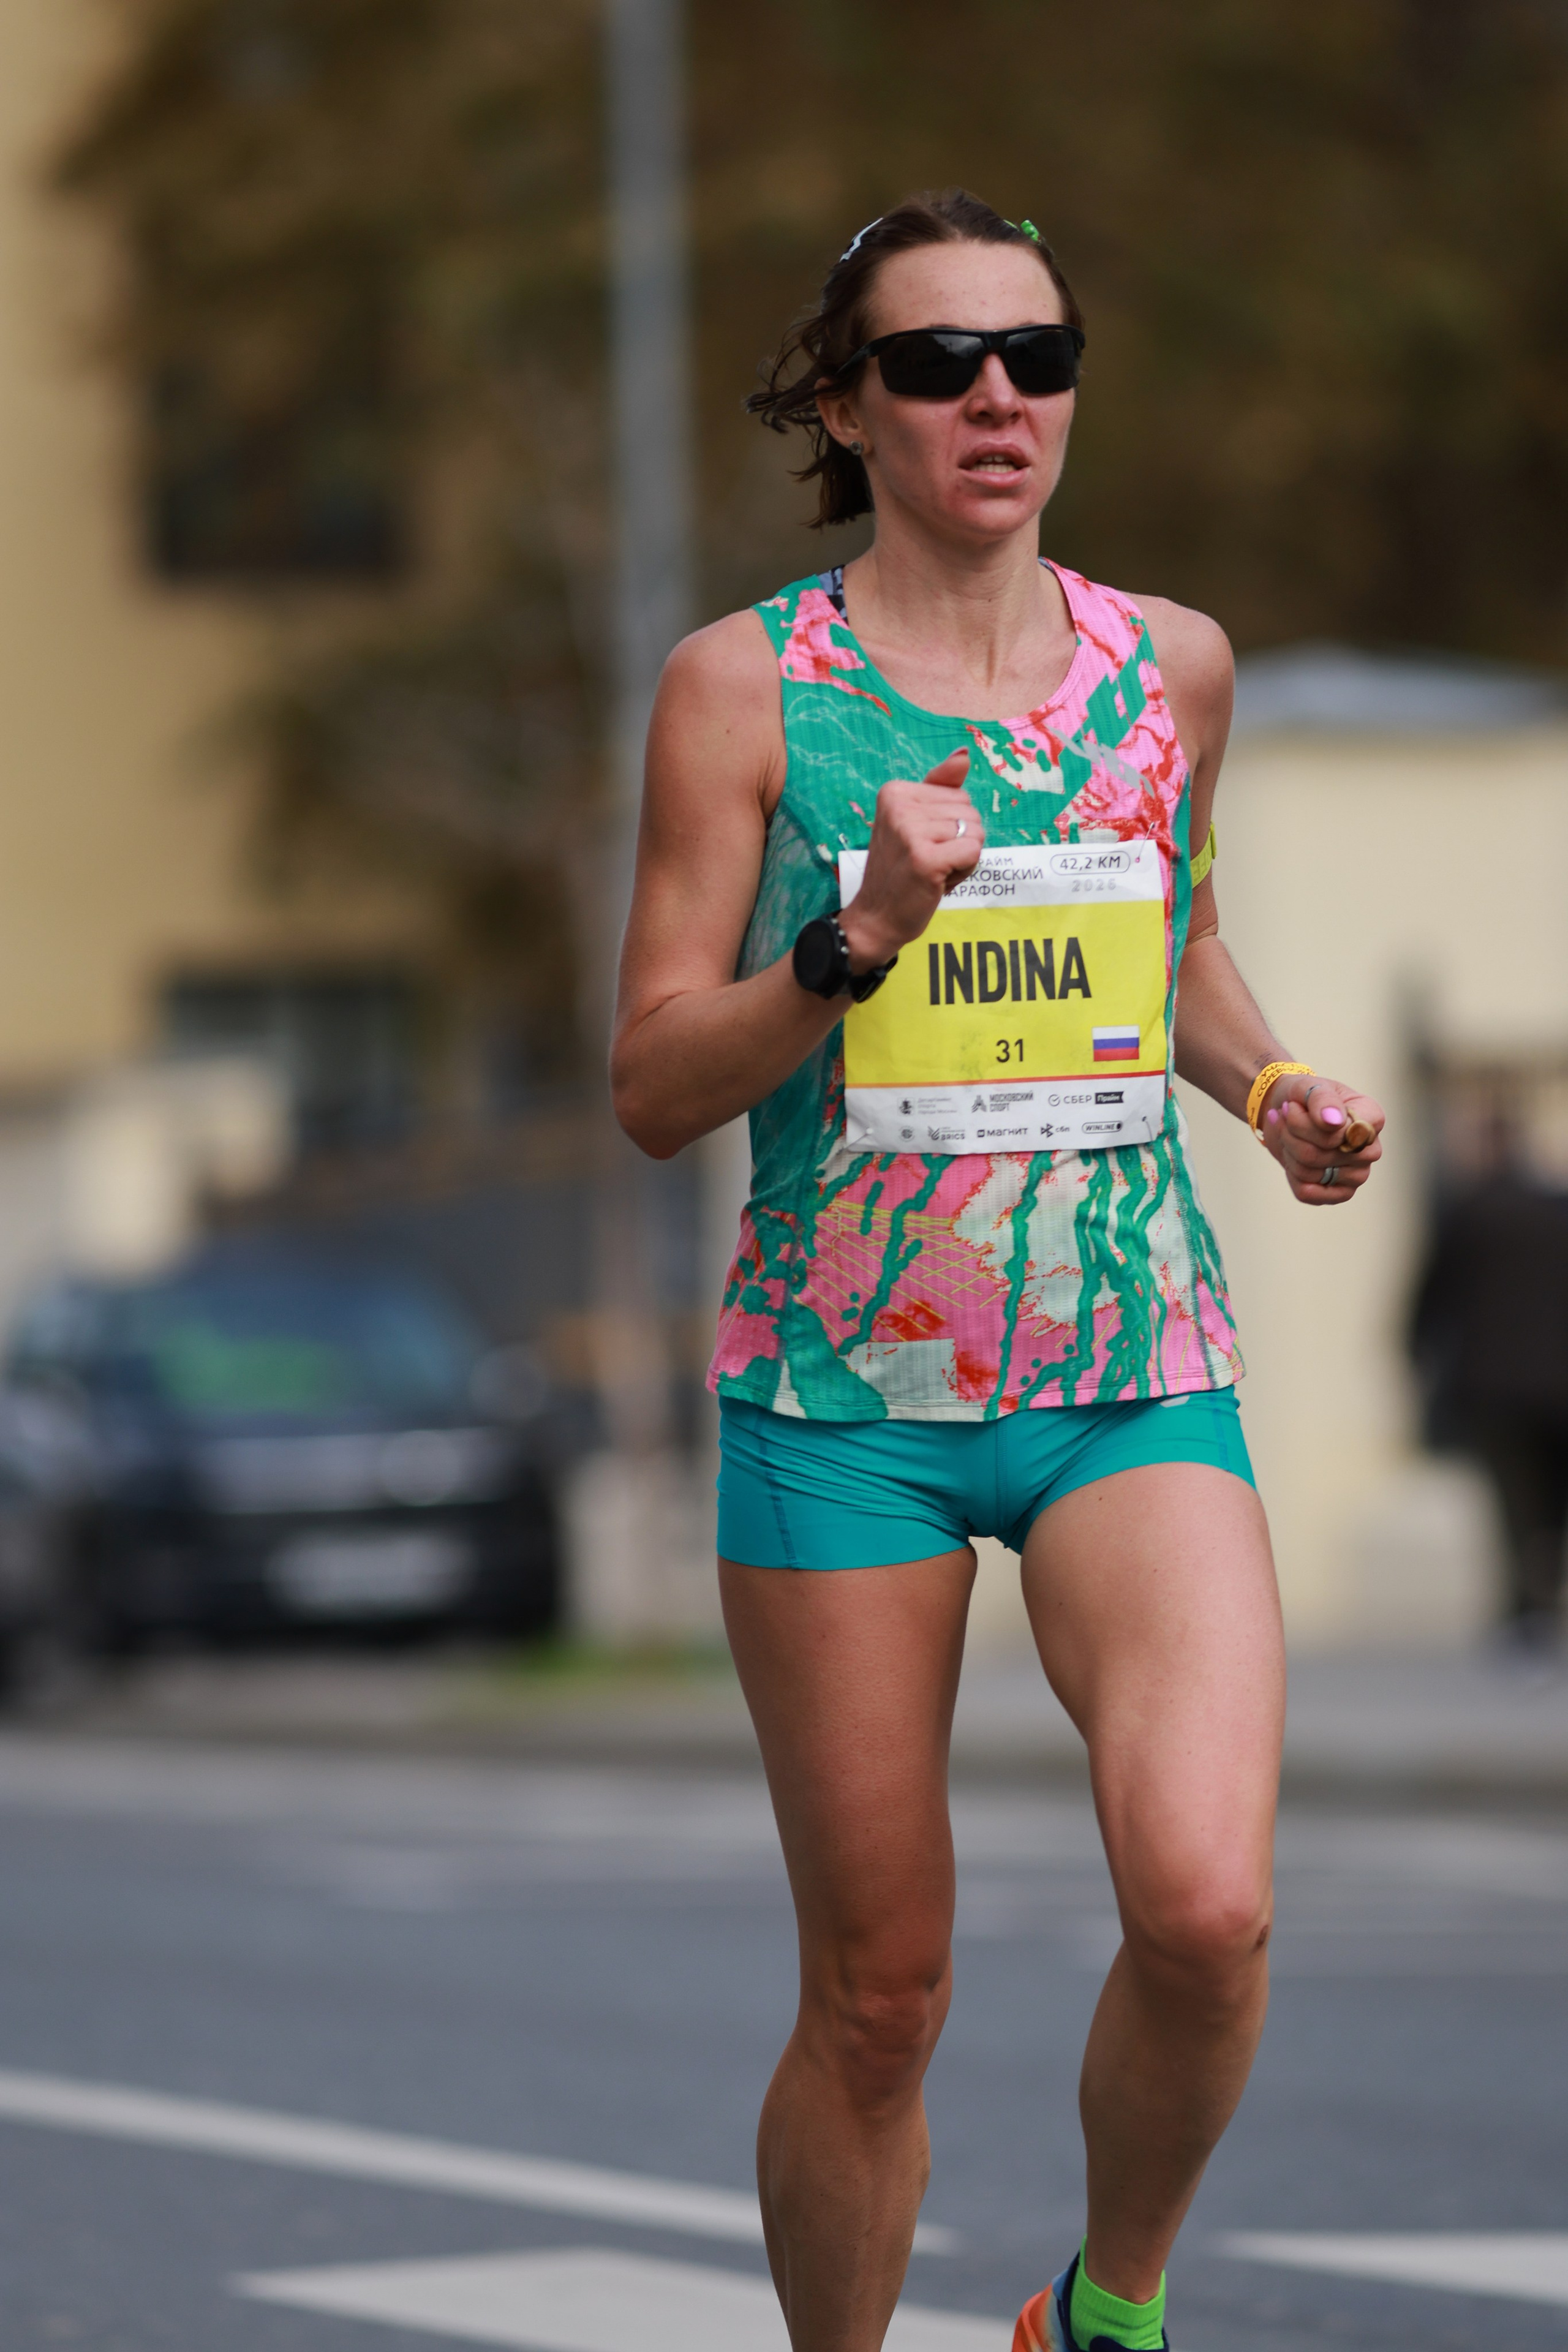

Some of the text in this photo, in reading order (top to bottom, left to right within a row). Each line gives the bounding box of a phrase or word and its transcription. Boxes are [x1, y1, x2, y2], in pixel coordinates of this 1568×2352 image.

[978, 856, 1013, 867] РАЙМ
[1060, 857, 1092, 871] 42,2
[963, 867, 1043, 882] КОВСКИЙ
[944, 883, 1016, 897] АРАФОН
[1071, 878, 1117, 892] 2026
[929, 937, 1092, 1005] INDINA
[996, 1039, 1023, 1063] 31
[1063, 1095, 1092, 1104] СБЕР
